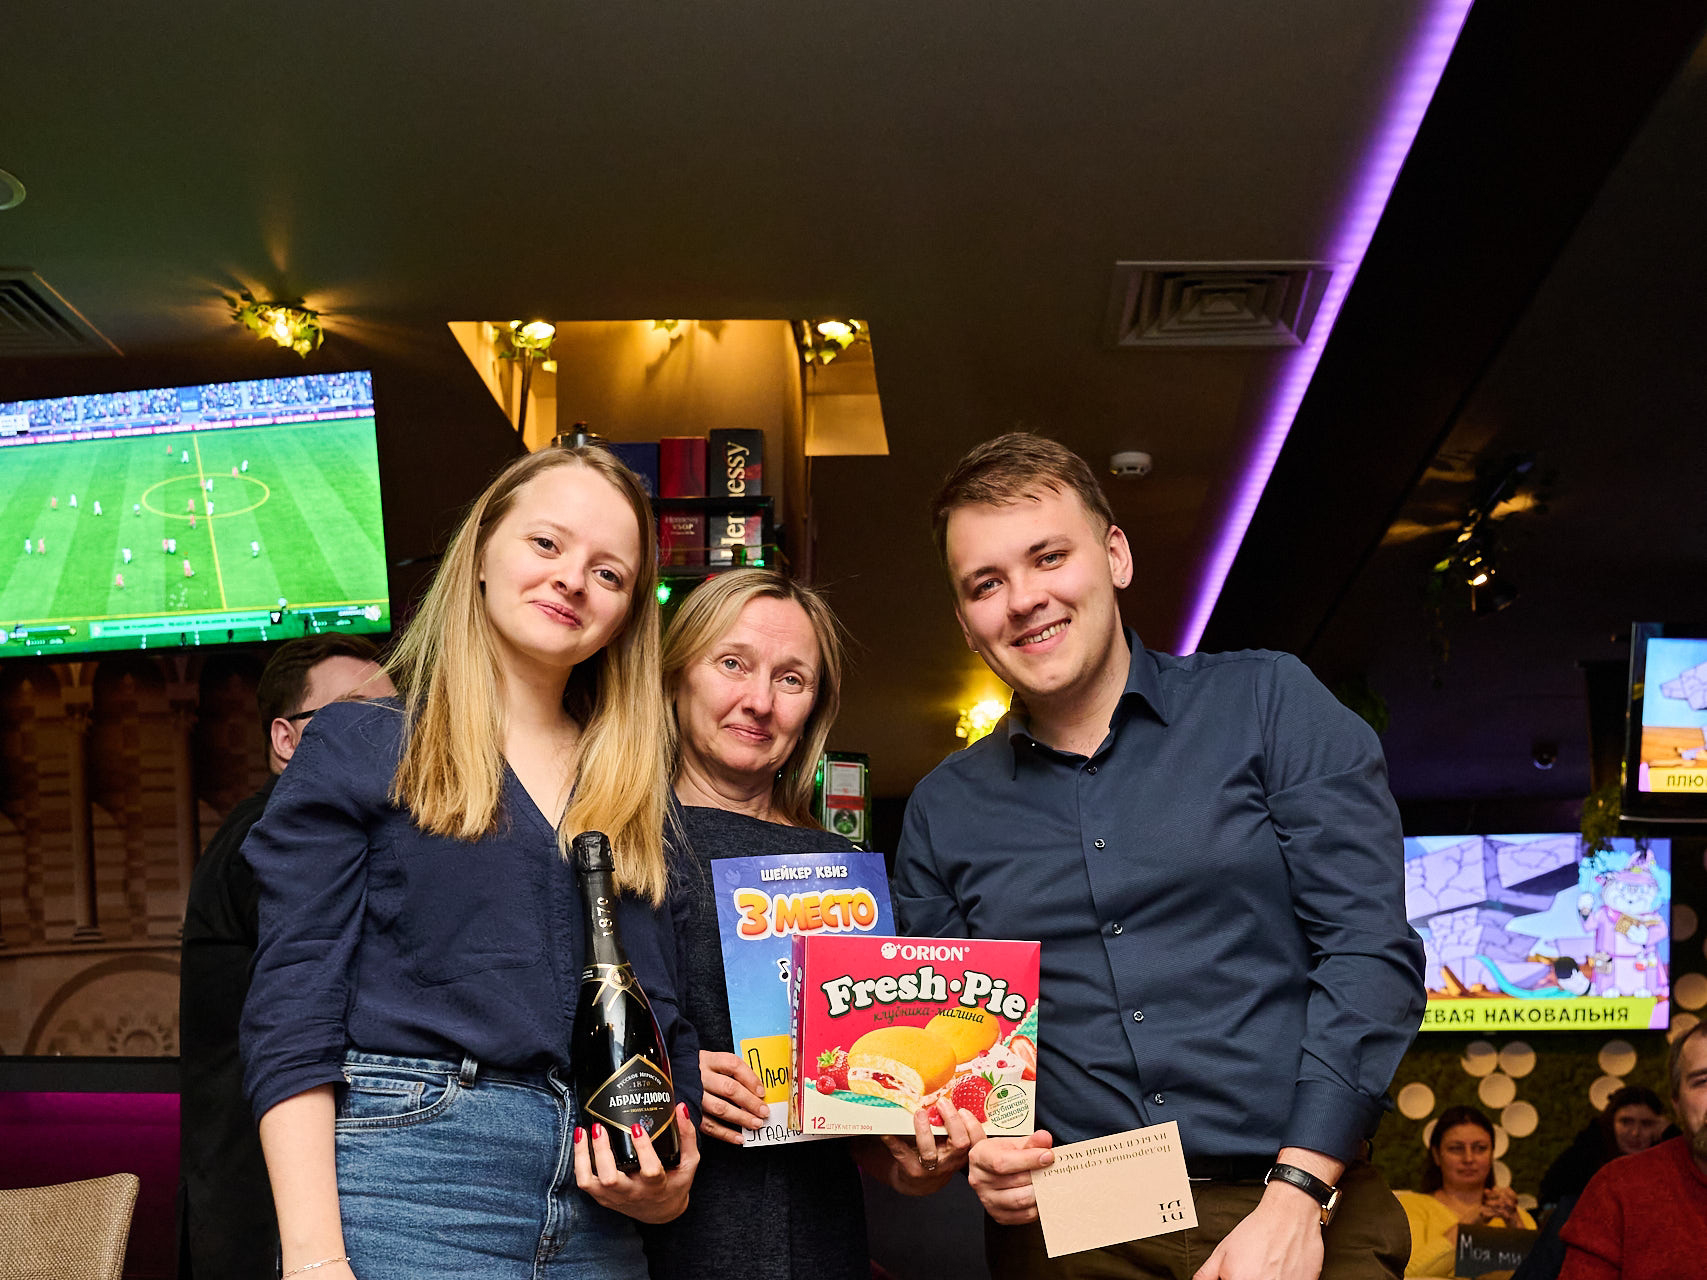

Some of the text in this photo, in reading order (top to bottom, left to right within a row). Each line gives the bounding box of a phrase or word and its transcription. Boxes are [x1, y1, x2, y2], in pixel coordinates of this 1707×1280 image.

[1667, 775, 1707, 787] ПЛЮ
[761, 865, 848, 881] ШЕЙКЕР КВИЗ
[596, 896, 614, 937] 1870
[738, 891, 875, 936] 3 МЕСТО
[872, 1004, 985, 1024] клубника-малина
[1424, 1007, 1629, 1024] ЕВАЯ НАКОВАЛЬНЯ
[747, 1047, 789, 1089] Плю
[811, 1116, 826, 1130] 12
[827, 1123, 841, 1131] ШТУК
[1043, 1159, 1103, 1177] сертификат
